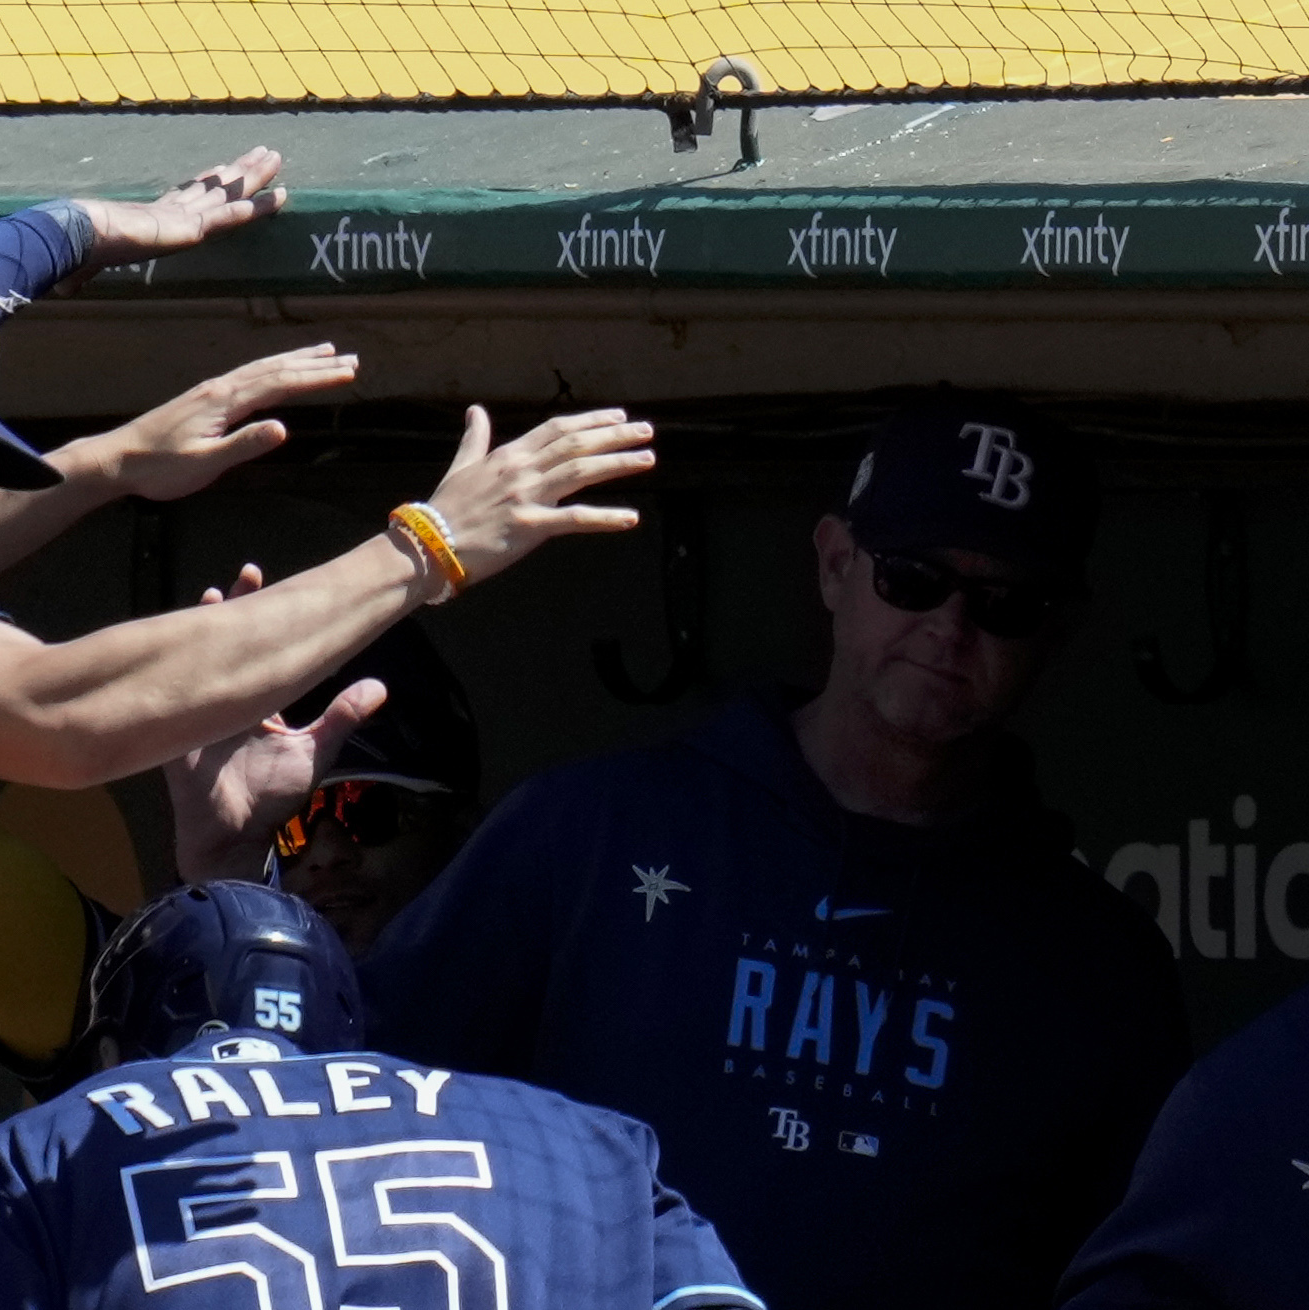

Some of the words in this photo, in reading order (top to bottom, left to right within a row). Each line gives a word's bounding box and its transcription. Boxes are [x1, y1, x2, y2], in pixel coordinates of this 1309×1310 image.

[310, 215, 432, 283] xfinity
[557, 212, 666, 279] xfinity
[787, 211, 898, 279] xfinity
[1021, 210, 1130, 277] xfinity
[958, 420, 1036, 511] TB
[253, 986, 305, 1034] 55
[726, 956, 957, 1090] RAYS
[86, 1062, 452, 1136] RALEY
[722, 1057, 939, 1118] BASEBALL
[766, 1105, 811, 1152] TB
